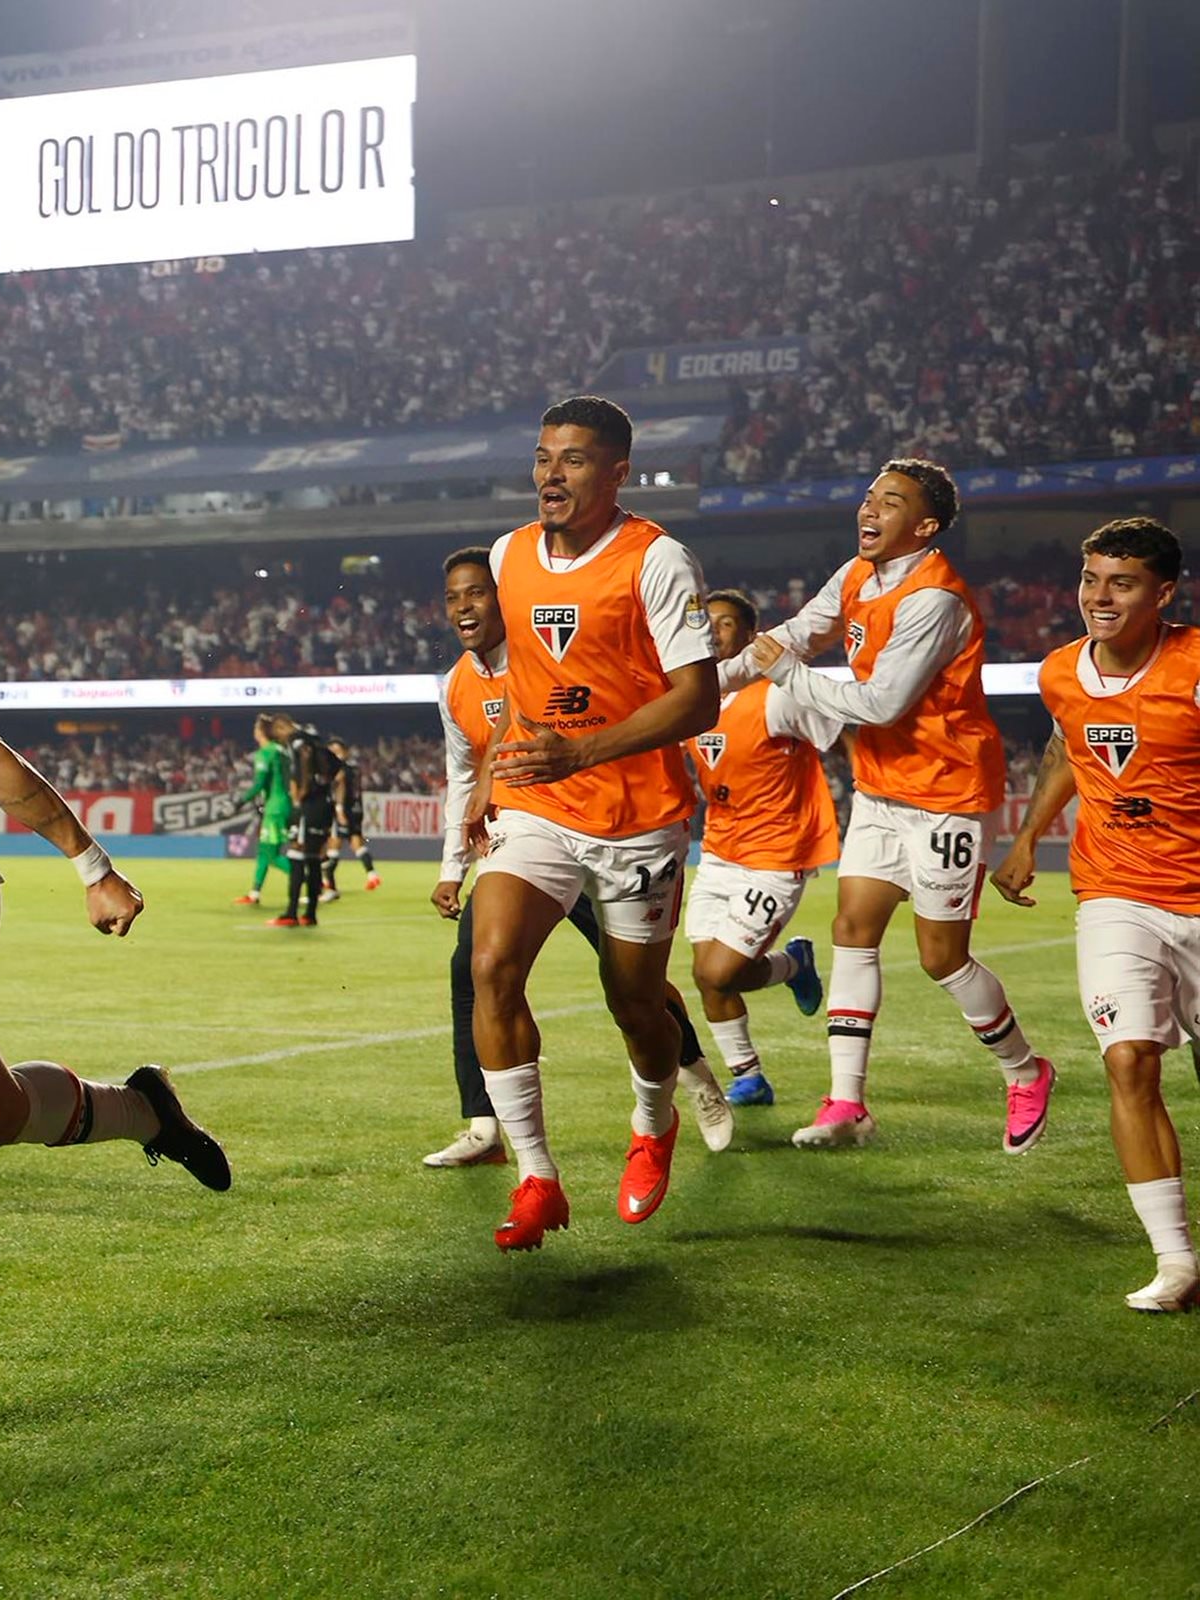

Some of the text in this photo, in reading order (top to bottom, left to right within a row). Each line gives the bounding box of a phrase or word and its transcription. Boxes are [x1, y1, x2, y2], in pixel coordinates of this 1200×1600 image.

[38, 105, 385, 219] GOL DO TRICOLOR
[534, 611, 574, 623] SPFC
[558, 716, 607, 730] balance
[1088, 729, 1133, 742] SPFC
[931, 832, 973, 869] 46
[744, 888, 777, 925] 49
